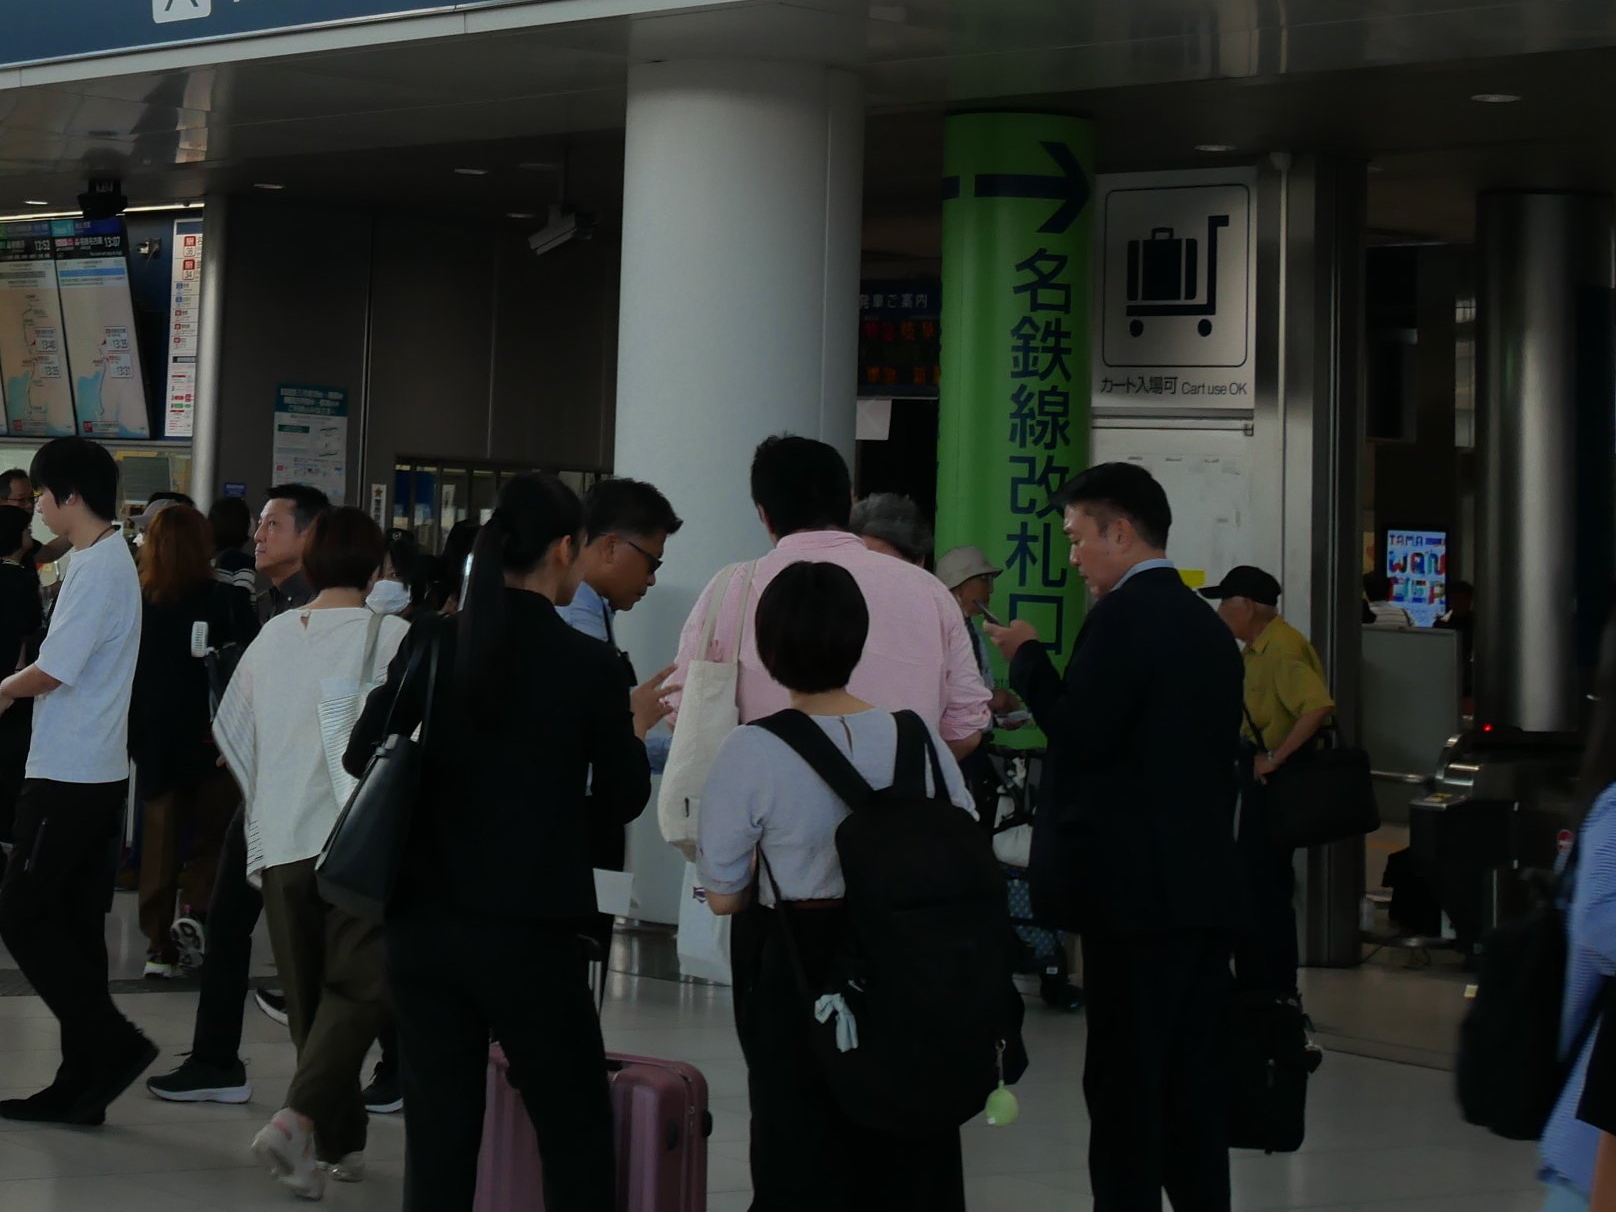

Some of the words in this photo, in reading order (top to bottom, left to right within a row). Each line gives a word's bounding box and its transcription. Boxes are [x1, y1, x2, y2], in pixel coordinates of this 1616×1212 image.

[1100, 376, 1179, 395] カート入場可
[1181, 382, 1206, 395] Cart
[1207, 384, 1228, 395] use
[1229, 382, 1248, 396] OK
[1005, 248, 1072, 656] 名鉄線改札口
